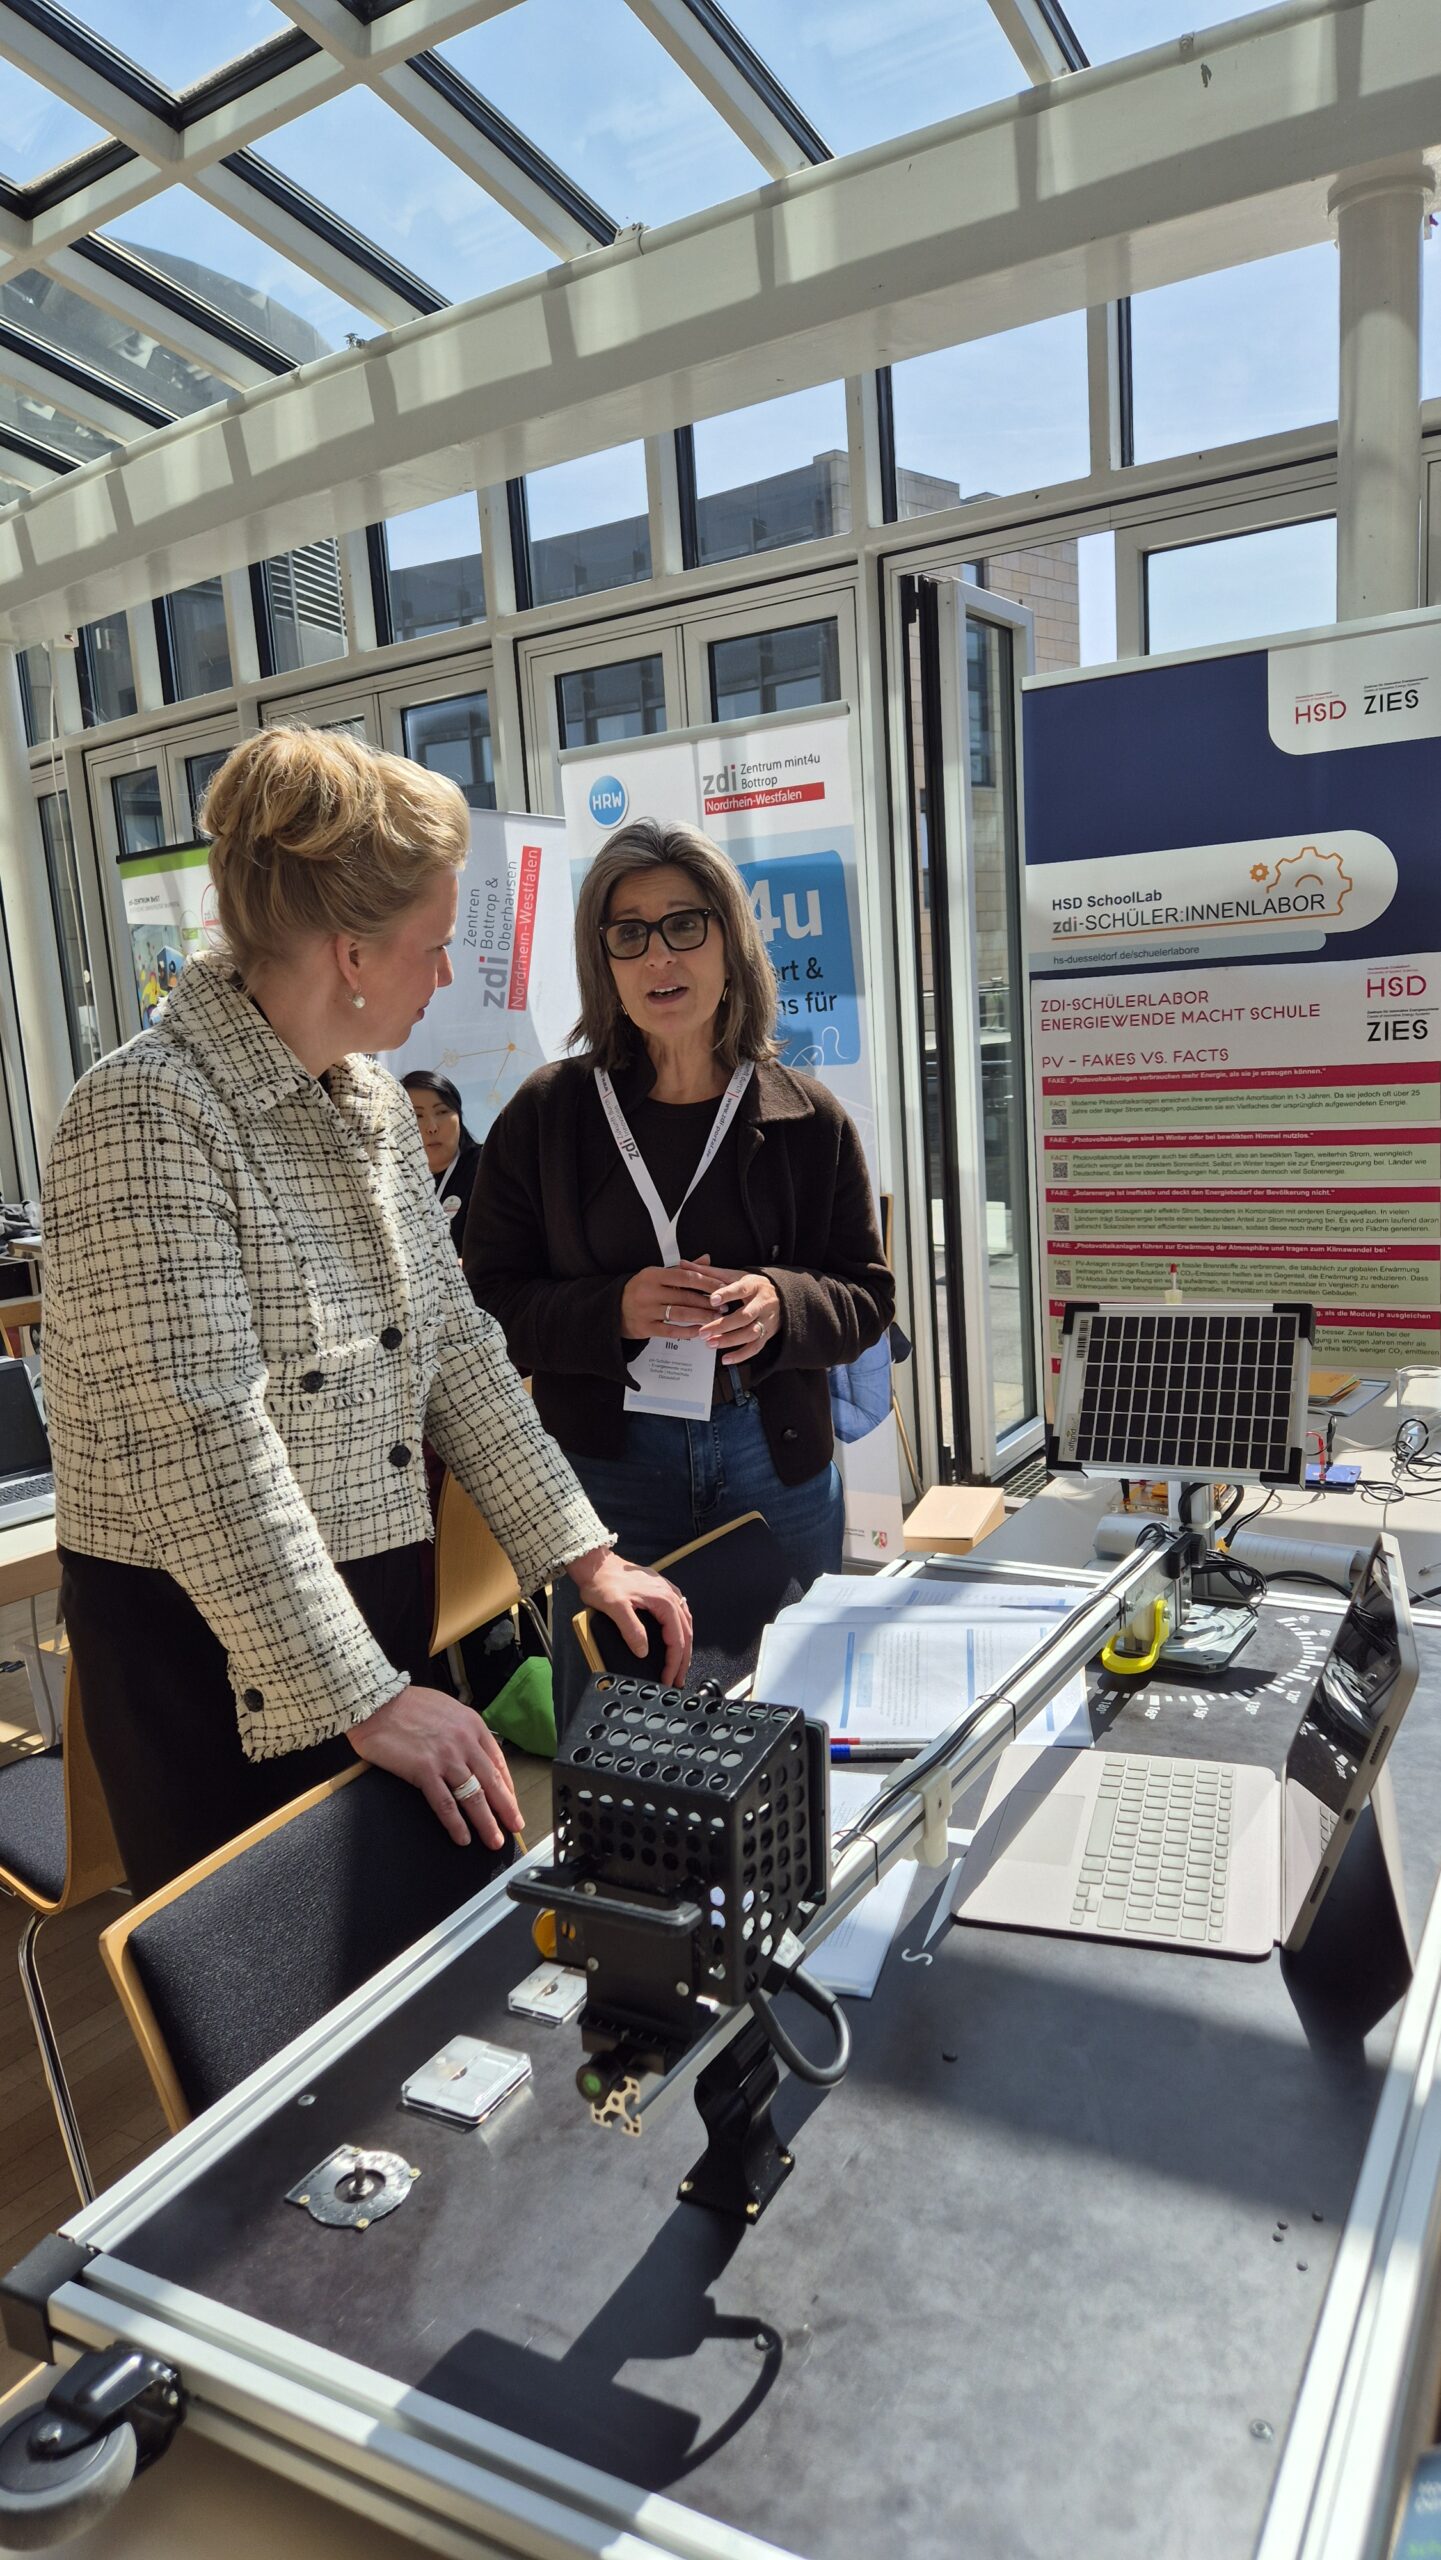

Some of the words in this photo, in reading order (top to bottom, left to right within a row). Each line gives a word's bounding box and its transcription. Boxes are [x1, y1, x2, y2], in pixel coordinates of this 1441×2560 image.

[1295, 700, 1347, 725] HSD
[1364, 689, 1419, 715] ZIES
[740, 760, 782, 775] Zentrum
[784, 754, 821, 768] mint4u
[703, 764, 737, 795] zdi
[741, 775, 778, 790] Bottrop
[592, 792, 622, 810] HRW
[706, 790, 802, 812] Nordrhein-Westfalen
[485, 877, 498, 888] &
[498, 860, 517, 951] Oberhausen
[1052, 897, 1083, 911] HSD
[1087, 890, 1162, 908] SchoolLab
[463, 888, 480, 947] Zentren
[480, 894, 500, 949] Bottrop
[1052, 893, 1326, 934] zdi-SCHÜLER:INNENLABOR
[511, 850, 538, 1008] Nordrhein-Westfalen
[1053, 946, 1200, 965] hs-duesseldorf.de/schuelerlabore
[806, 957, 824, 980] &
[478, 956, 508, 1009] zdi
[1367, 975, 1427, 998] HSD
[805, 992, 838, 1013] für
[1041, 990, 1209, 1013] ZDI-SCHÜLERLABOR
[1041, 1012, 1175, 1031] ENERGIEWENDE
[1181, 1008, 1245, 1024] MACHT
[1250, 1003, 1320, 1020] SCHULE
[1367, 1019, 1428, 1041] ZIES
[1042, 1056, 1064, 1068] PV
[1082, 1053, 1136, 1067] FAKES
[1140, 1051, 1168, 1064] VS.
[1173, 1048, 1229, 1063] FACTS
[619, 1137, 640, 1160] zdi
